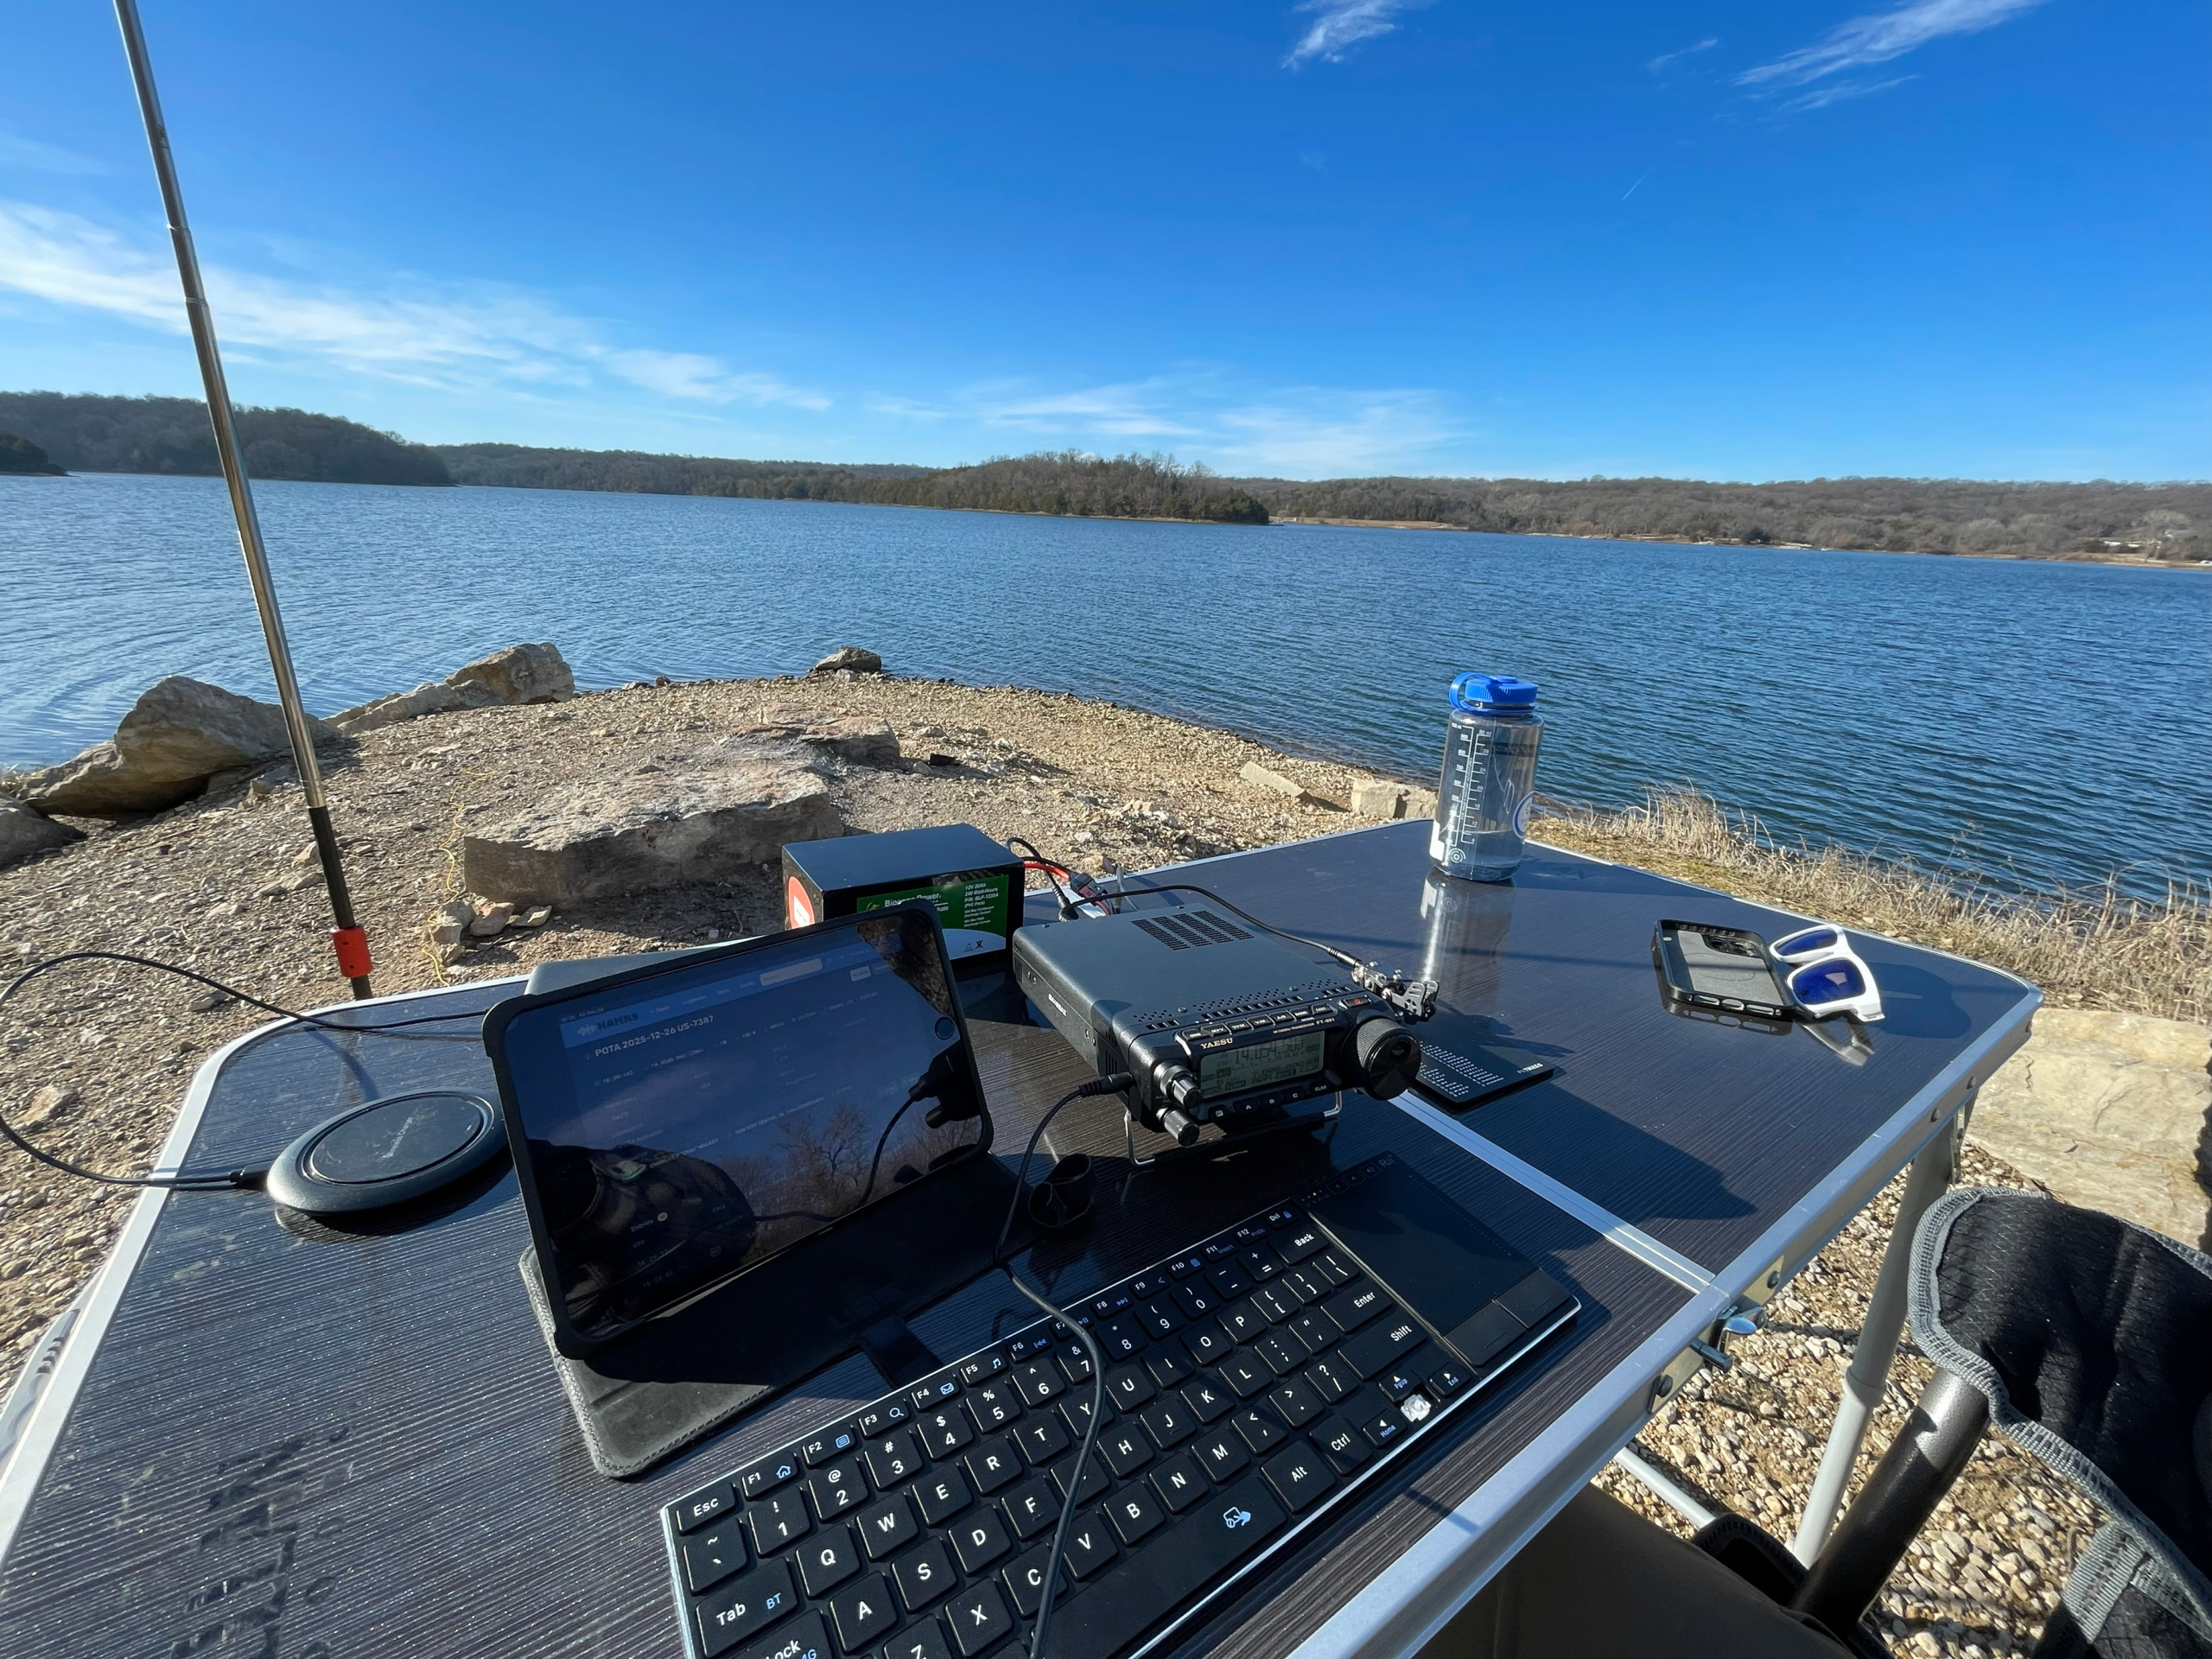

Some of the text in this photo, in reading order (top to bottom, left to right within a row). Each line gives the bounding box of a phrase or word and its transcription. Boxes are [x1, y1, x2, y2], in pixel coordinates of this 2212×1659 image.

[594, 1014, 715, 1058] POTA 2025-12-26 US-7387
[1200, 1037, 1234, 1050] YAESU
[1268, 1212, 1281, 1222] Del
[631, 1218, 654, 1232] Entries
[1236, 1228, 1249, 1238] F12
[1294, 1232, 1315, 1248] Back
[1205, 1244, 1218, 1255] F11
[1171, 1261, 1185, 1272] F10
[1135, 1281, 1146, 1291] F9
[1096, 1300, 1108, 1310] F8
[1195, 1299, 1206, 1309] 0
[1353, 1291, 1376, 1308] Enter
[1160, 1319, 1170, 1329] 9
[1235, 1315, 1246, 1328] P
[1390, 1324, 1413, 1342] Shift
[1012, 1341, 1024, 1352] F6
[1121, 1338, 1132, 1351] 8
[1199, 1336, 1211, 1348] O
[1071, 1346, 1082, 1356] &
[965, 1363, 979, 1376] F5
[1080, 1359, 1090, 1372] 7
[1238, 1367, 1252, 1380] L
[1038, 1382, 1050, 1395] 6
[1122, 1378, 1135, 1392] U
[916, 1388, 931, 1400] F4
[982, 1389, 995, 1402] %
[1200, 1389, 1215, 1404] K
[992, 1406, 1005, 1421] 5
[1079, 1402, 1091, 1415] Y
[863, 1414, 878, 1426] F3
[936, 1415, 946, 1427] $
[1165, 1414, 1174, 1428] J
[1033, 1427, 1046, 1442] T
[1379, 1424, 1396, 1438] Home
[944, 1432, 957, 1446] 4
[1330, 1433, 1351, 1452] Ctrl
[808, 1440, 823, 1454] F2
[884, 1440, 894, 1453] #
[1117, 1439, 1134, 1456] H
[1211, 1443, 1229, 1461] M
[891, 1459, 904, 1474] 3
[986, 1455, 1001, 1471] R
[747, 1471, 762, 1485] F1
[827, 1468, 842, 1484] @
[1170, 1471, 1186, 1489] N
[1290, 1466, 1309, 1483] Alt
[836, 1490, 849, 1506] 2
[935, 1484, 950, 1500] E
[692, 1497, 720, 1517] Esc
[1024, 1497, 1036, 1514] F
[1126, 1502, 1141, 1519] B
[778, 1521, 789, 1537] 1
[877, 1512, 895, 1533] W
[971, 1528, 986, 1547] D
[1077, 1532, 1092, 1550] V
[820, 1548, 836, 1566] Q
[917, 1561, 931, 1581] S
[1027, 1567, 1041, 1586] C
[765, 1592, 782, 1610] BT
[715, 1602, 747, 1626] Tab
[858, 1600, 873, 1621] A
[970, 1604, 988, 1626] X
